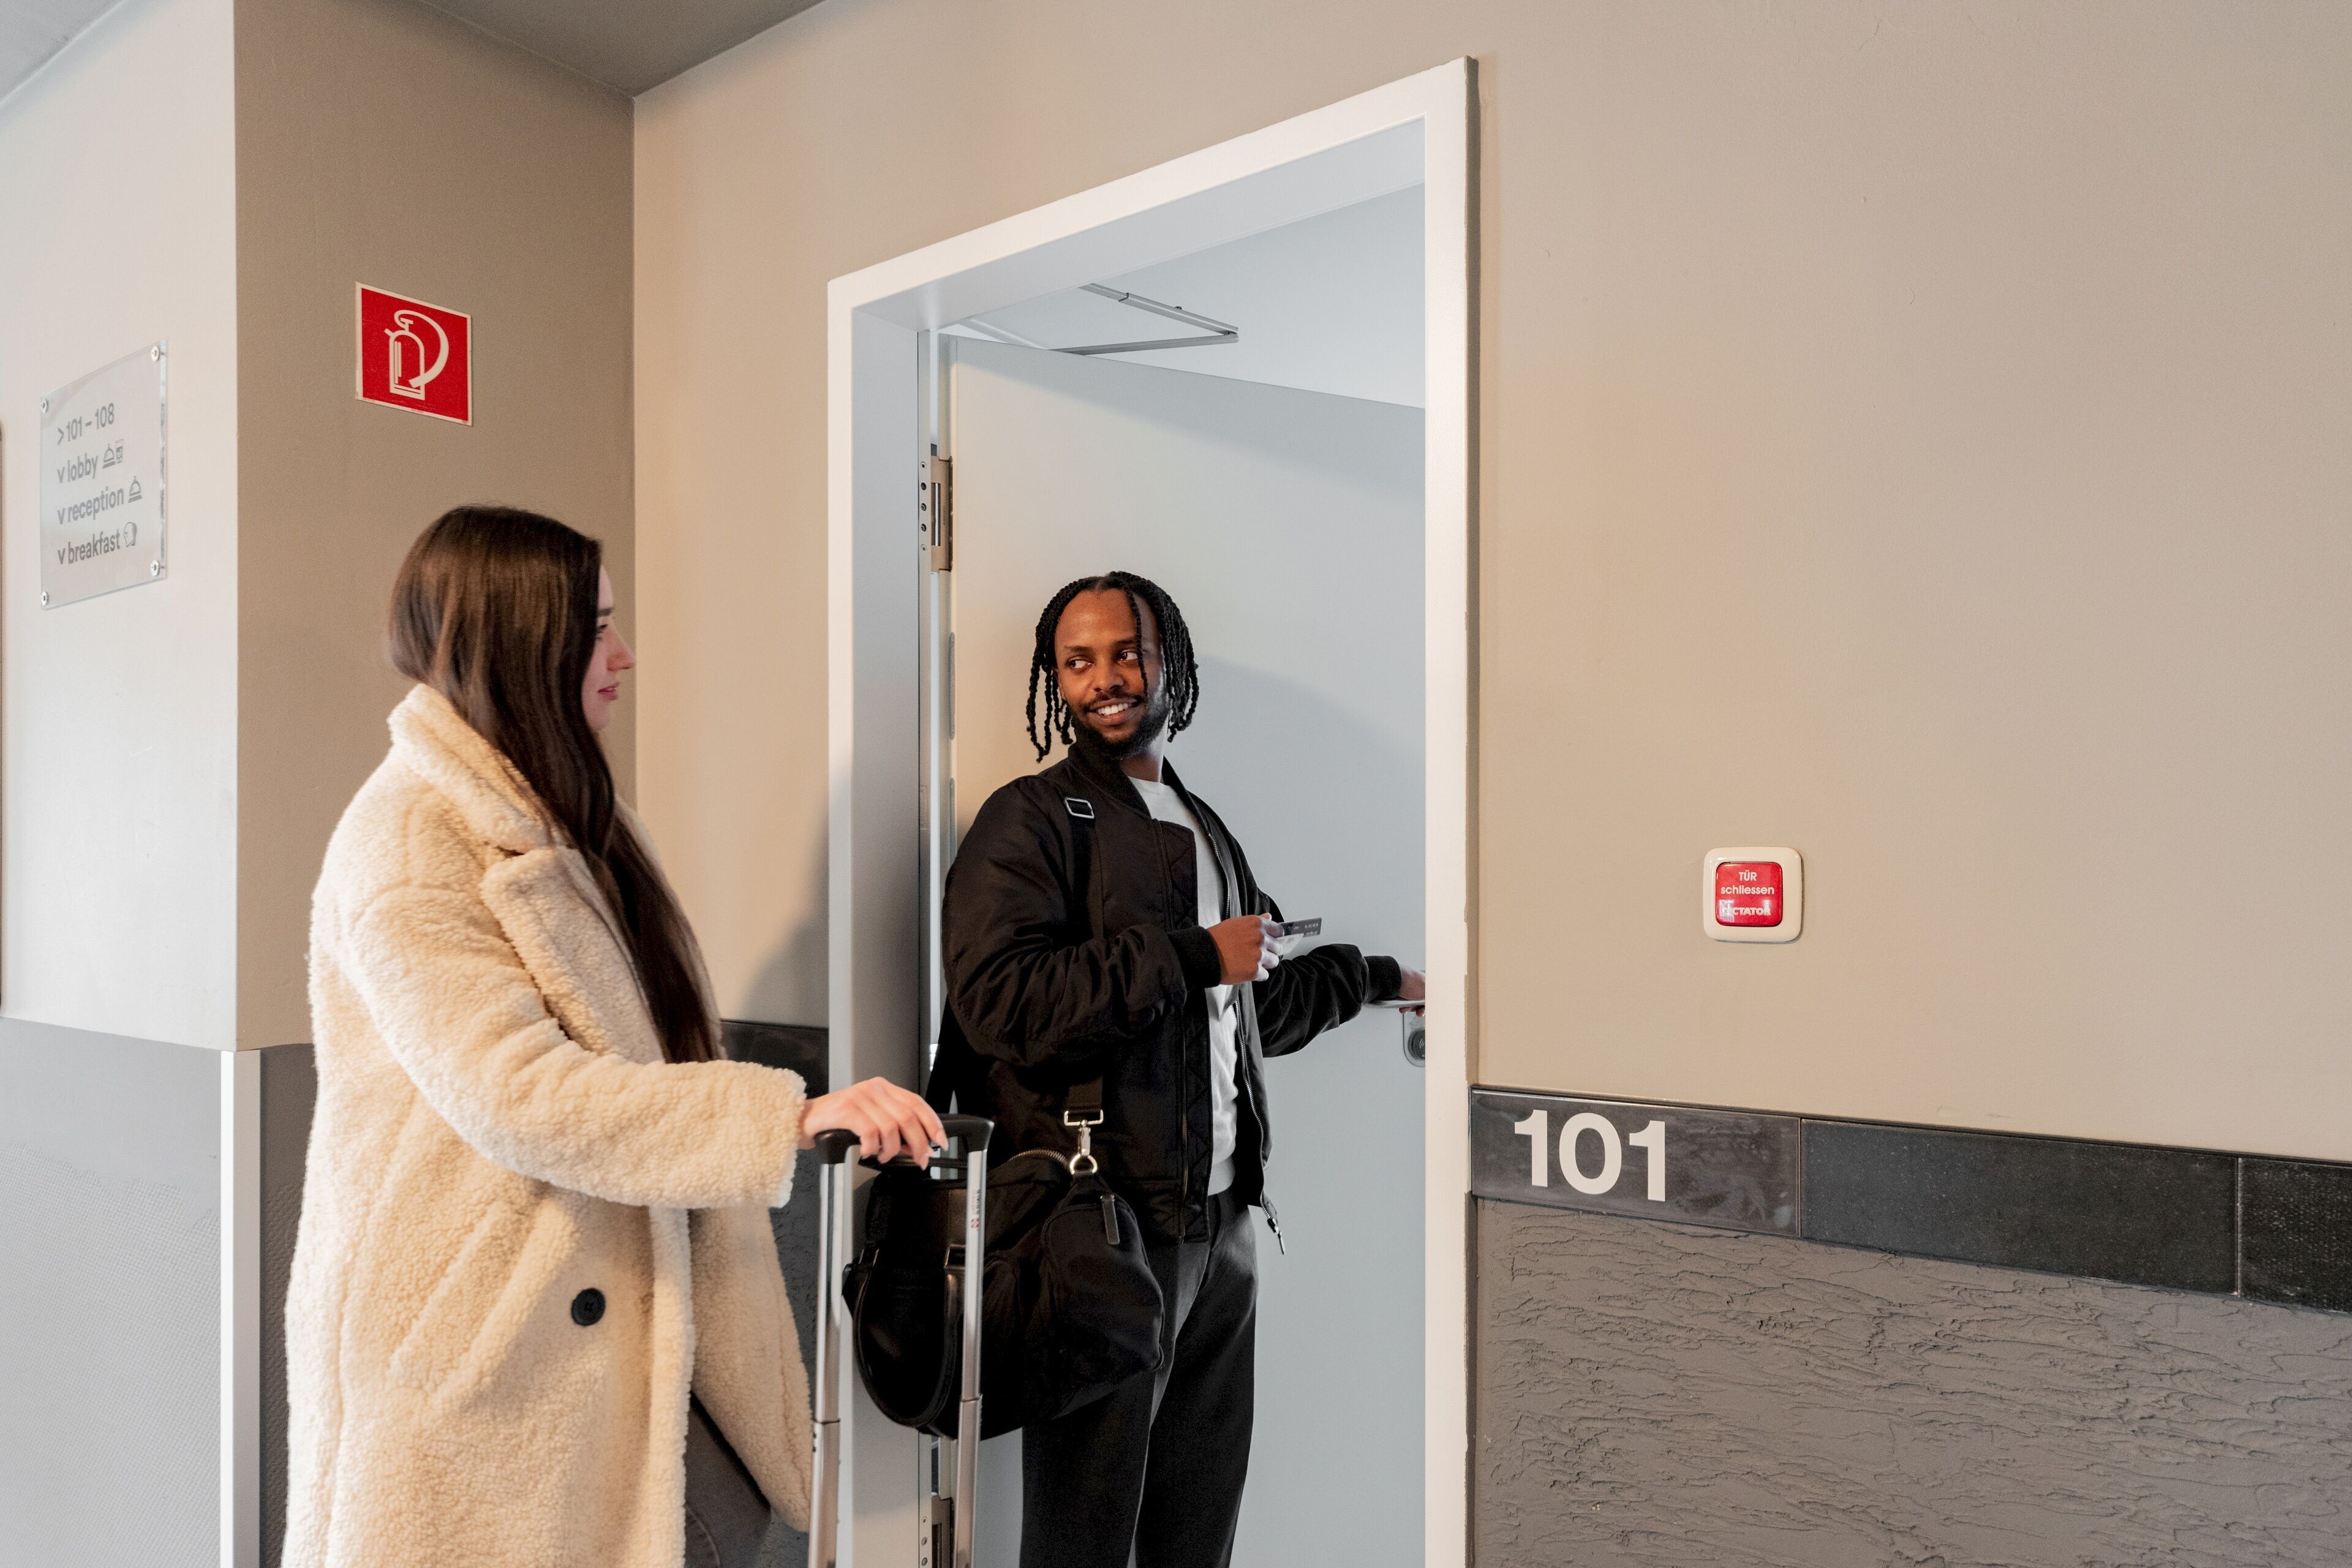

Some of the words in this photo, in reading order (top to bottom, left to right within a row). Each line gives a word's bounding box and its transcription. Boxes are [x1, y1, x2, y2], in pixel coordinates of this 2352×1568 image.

[66, 416, 83, 442] 101
[94, 402, 115, 430] 108
[67, 453, 99, 483] lobby
[67, 486, 124, 523] reception
[67, 529, 121, 565] breakfast
[1720, 884, 1775, 895] schliessen
[1738, 870, 1757, 881] TÜR
[1514, 1109, 1665, 1202] 101
